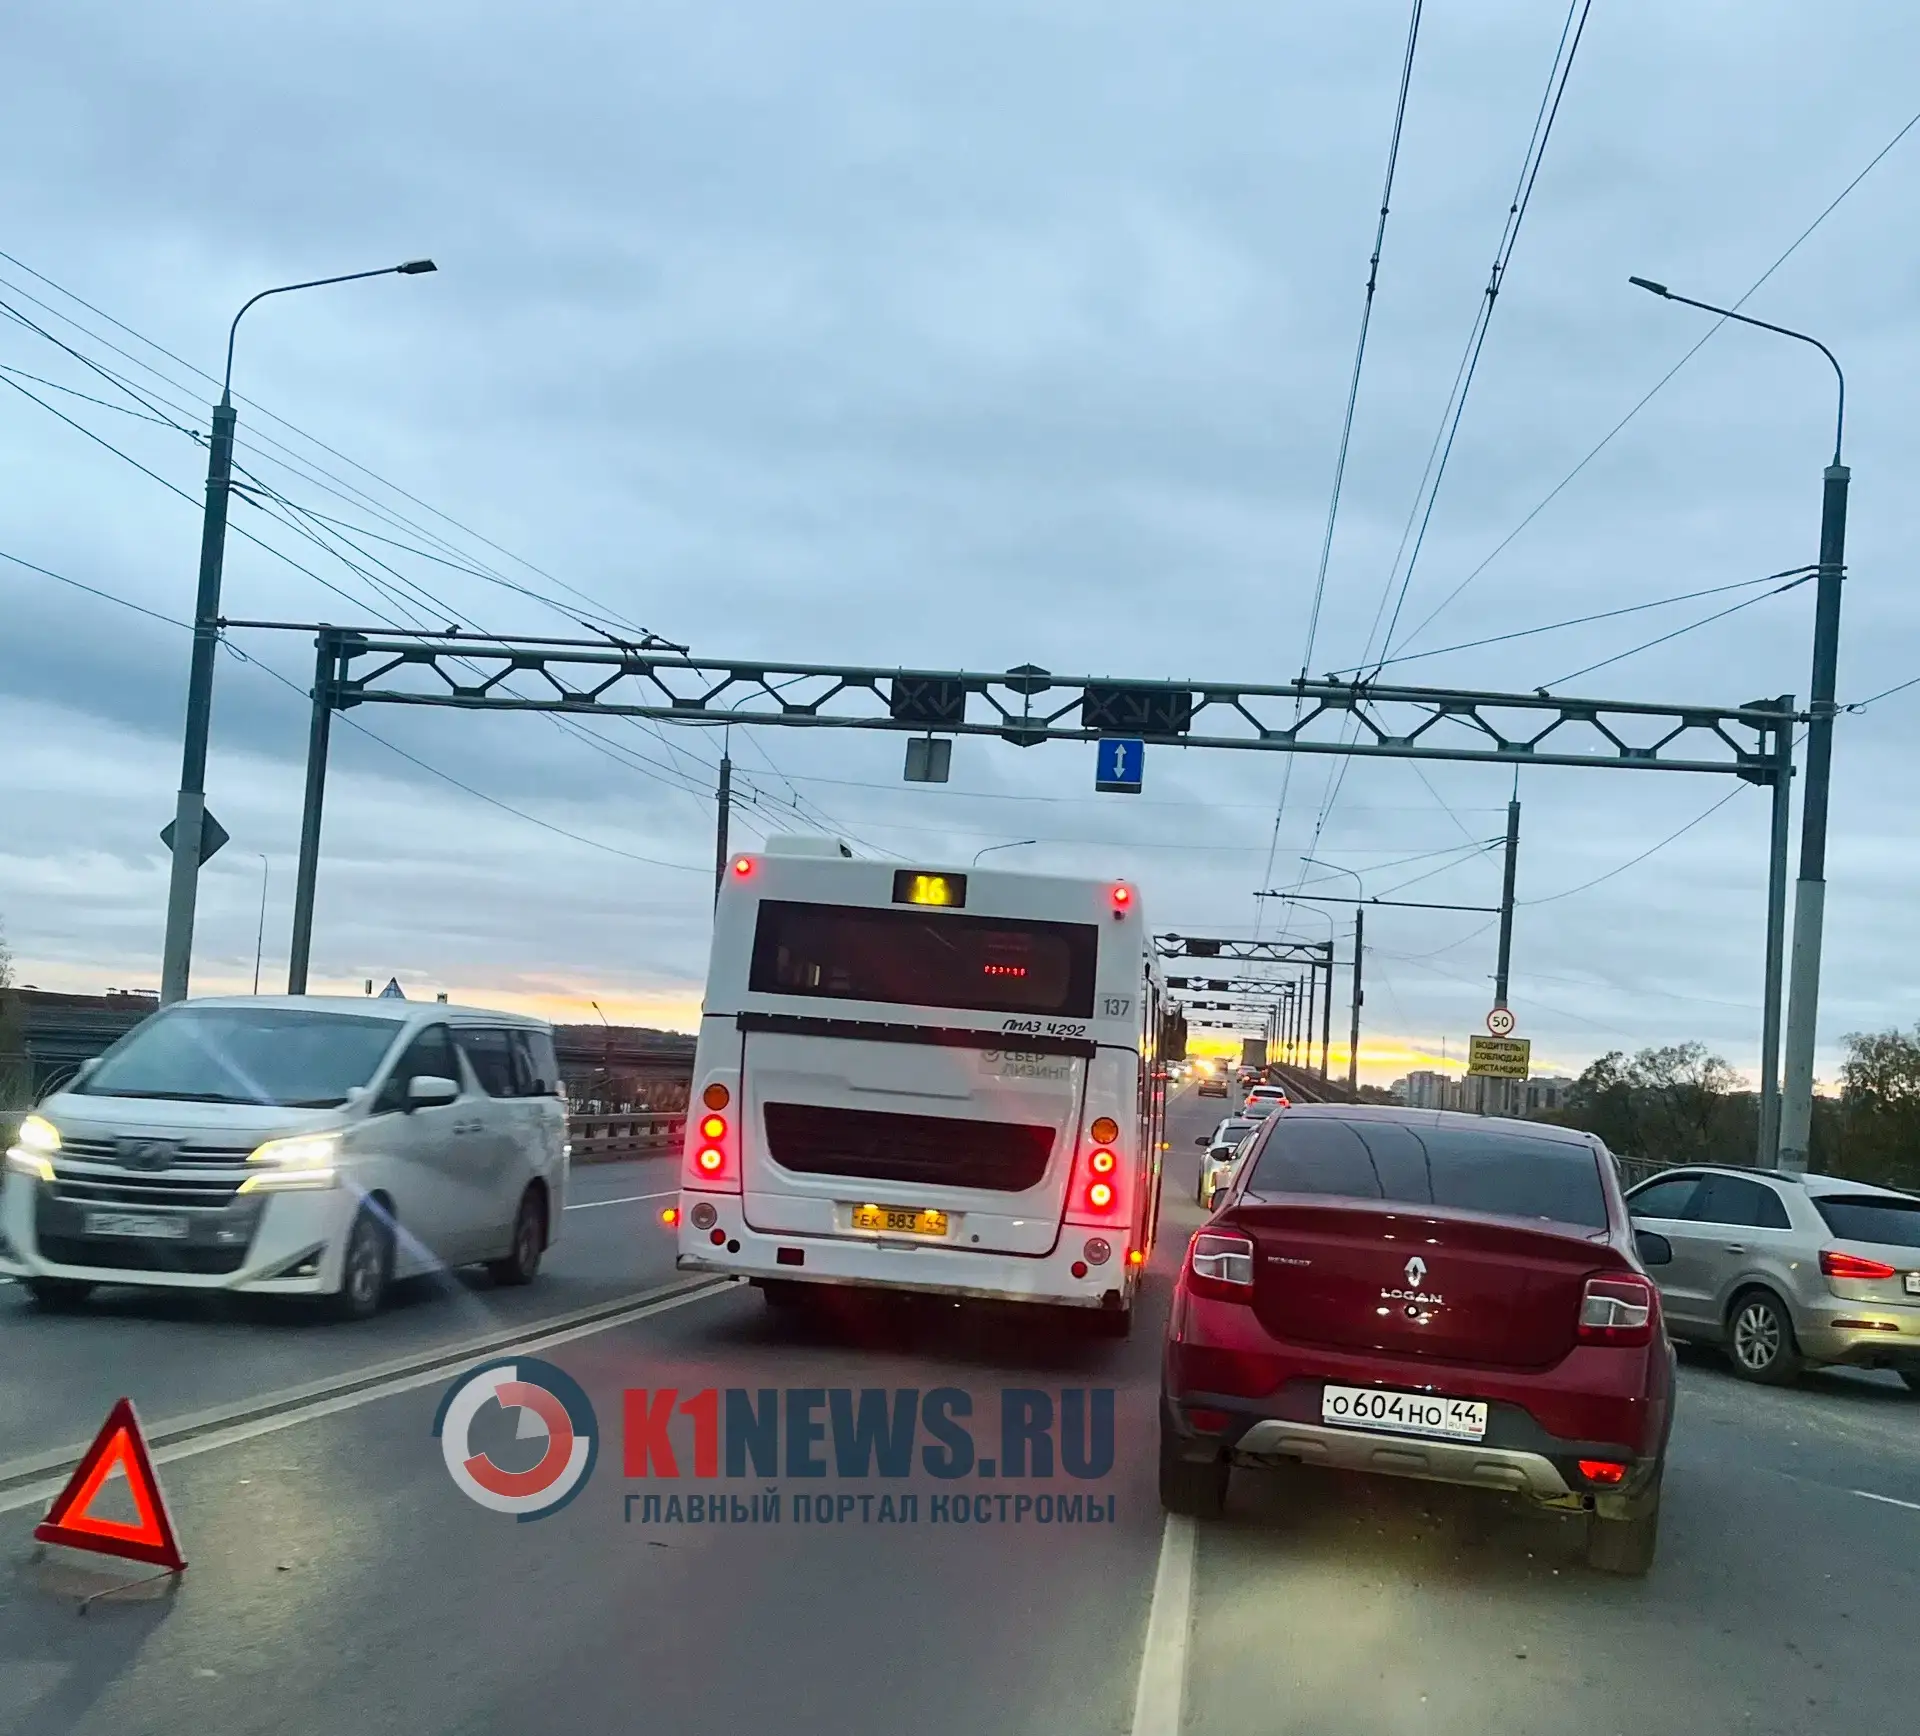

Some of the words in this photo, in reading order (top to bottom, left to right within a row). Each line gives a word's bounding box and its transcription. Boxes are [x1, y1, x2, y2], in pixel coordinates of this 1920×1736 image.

[914, 875, 945, 904] 16
[1104, 999, 1129, 1016] 137
[1046, 1022, 1086, 1037] 4292
[1493, 1016, 1509, 1028] 50
[1474, 1052, 1525, 1063] СОБЛЮДАЙ
[1002, 1062, 1069, 1080] ЛИЗИНГ
[1380, 1287, 1443, 1304] LOGAN
